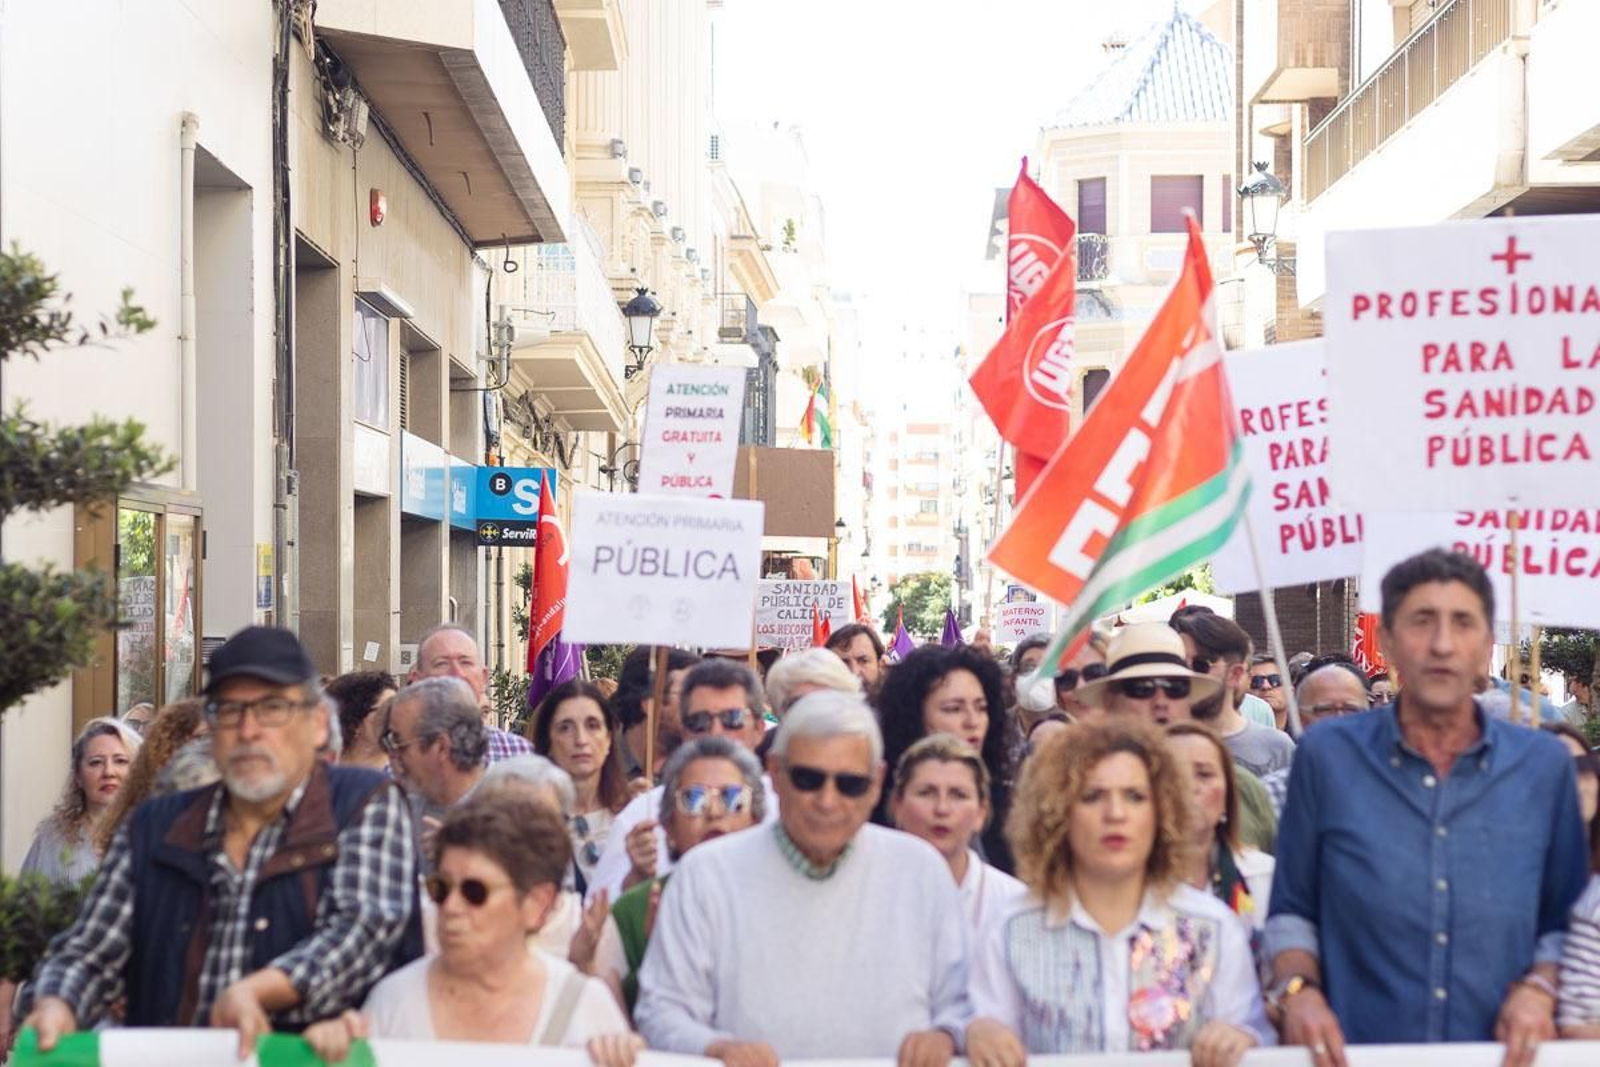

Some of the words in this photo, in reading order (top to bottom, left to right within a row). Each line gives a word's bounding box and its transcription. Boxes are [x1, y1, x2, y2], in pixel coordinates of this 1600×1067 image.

[1422, 340, 1514, 373] PARA
[666, 381, 730, 395] ATENCIÓN
[1425, 385, 1594, 419] SANIDAD
[665, 407, 724, 419] PRIMARIA
[662, 431, 722, 442] GRATUITA
[1428, 427, 1590, 468] PÚBLICA
[687, 453, 695, 464] Y
[495, 480, 506, 490] B
[661, 472, 713, 487] PÚBLICA
[596, 510, 669, 528] ATENCIÓN
[672, 514, 744, 532] PRIMARIA
[592, 539, 740, 581] PÚBLICA
[772, 583, 838, 596] SANIDAD
[827, 597, 845, 609] DE
[1002, 607, 1045, 617] MATERNO
[1014, 628, 1025, 636] YA
